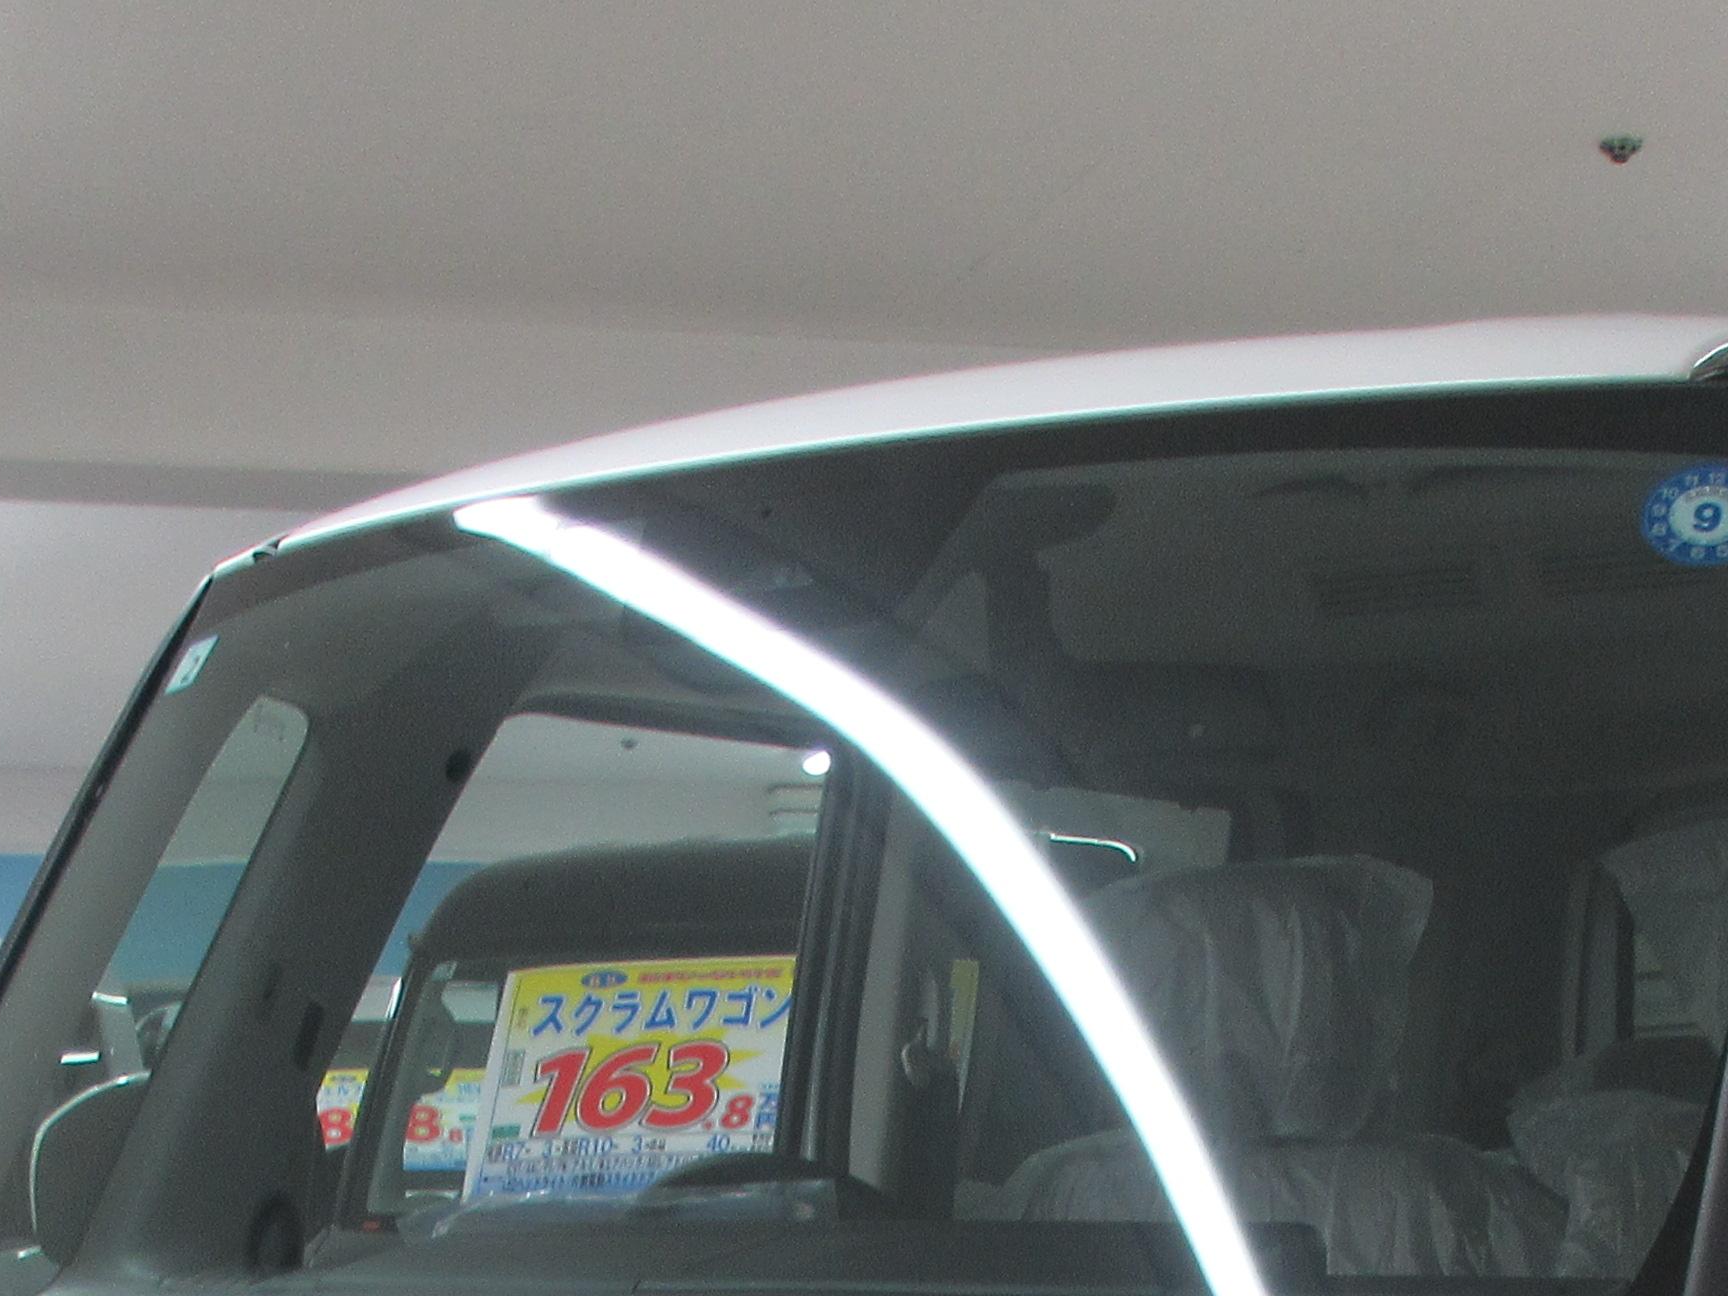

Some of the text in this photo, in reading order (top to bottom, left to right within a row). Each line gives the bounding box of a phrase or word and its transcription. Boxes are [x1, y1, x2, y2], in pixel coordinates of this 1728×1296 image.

[1693, 502, 1722, 532] 9
[532, 984, 791, 1037] スクラムワゴン
[532, 1040, 755, 1137] 163.8
